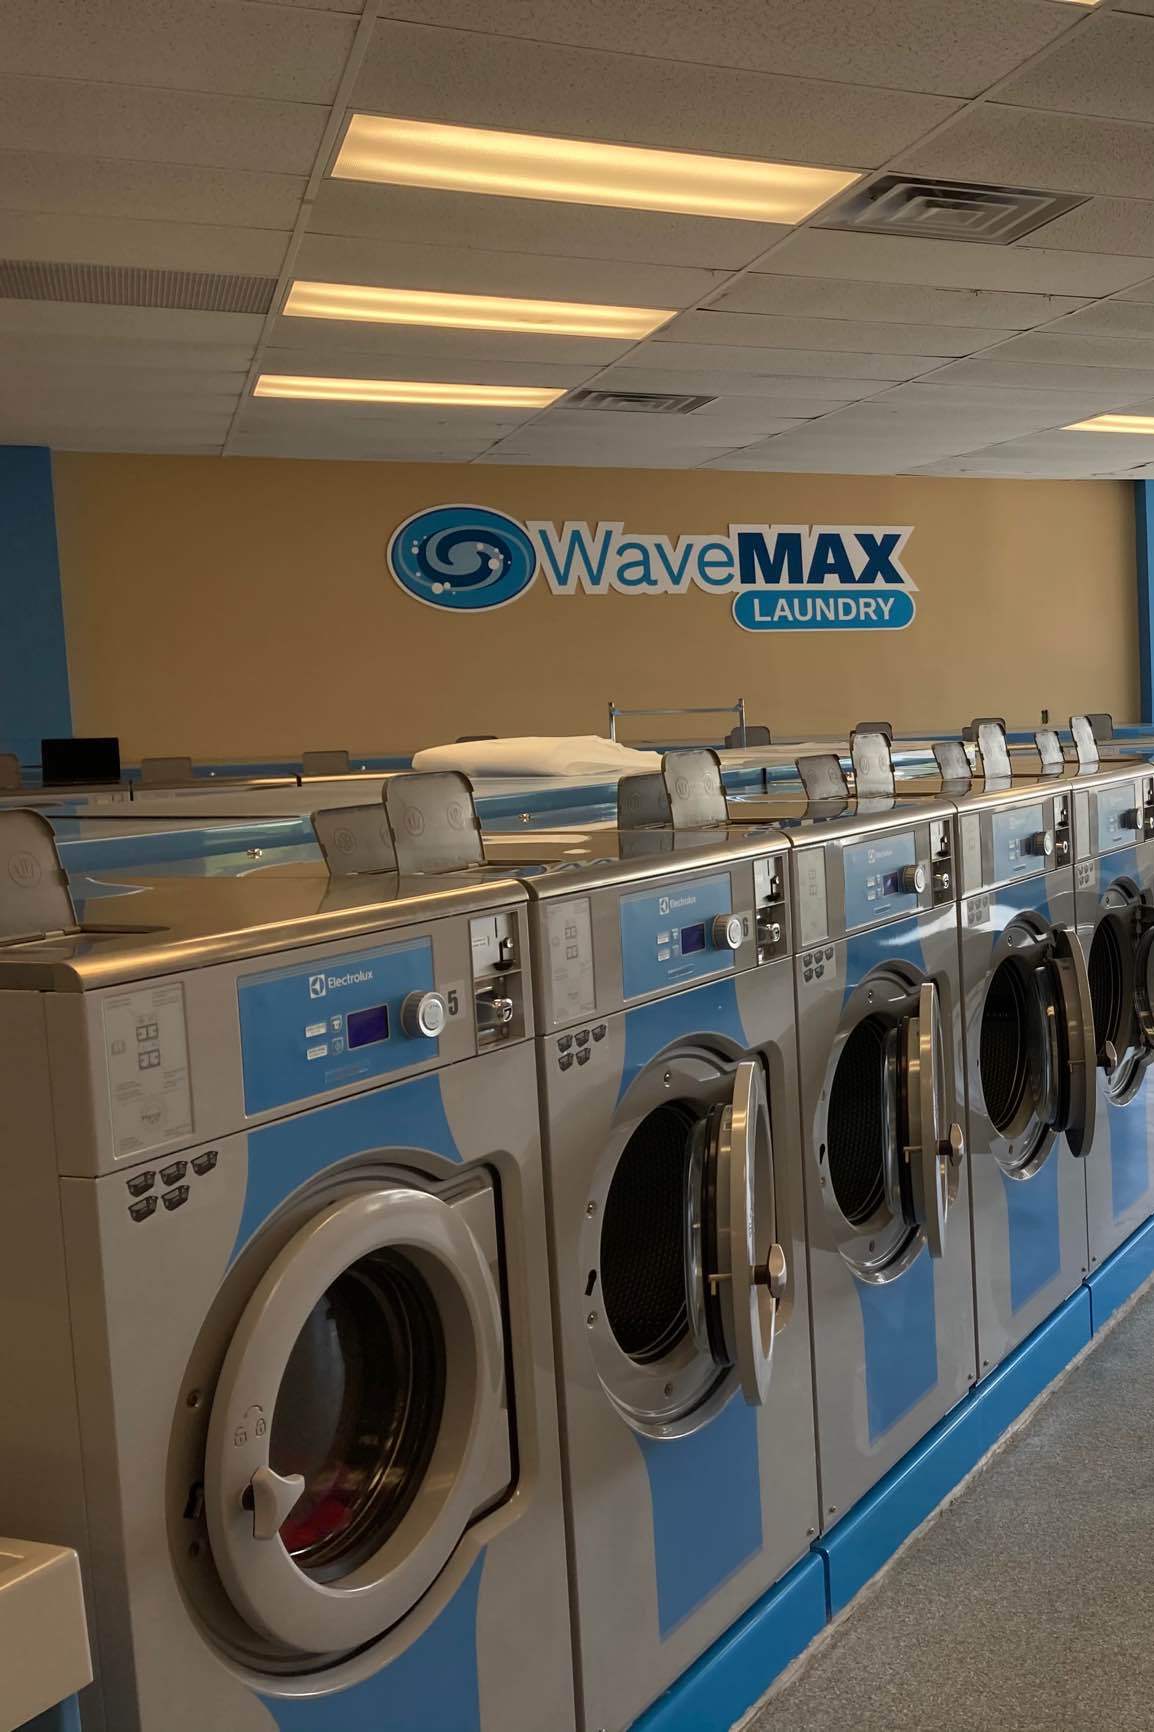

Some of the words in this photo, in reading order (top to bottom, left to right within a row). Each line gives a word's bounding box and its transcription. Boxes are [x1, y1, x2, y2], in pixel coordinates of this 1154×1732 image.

[752, 597, 897, 622] LAUNDRY
[327, 969, 373, 989] Electrolux
[447, 989, 459, 1016] 5
